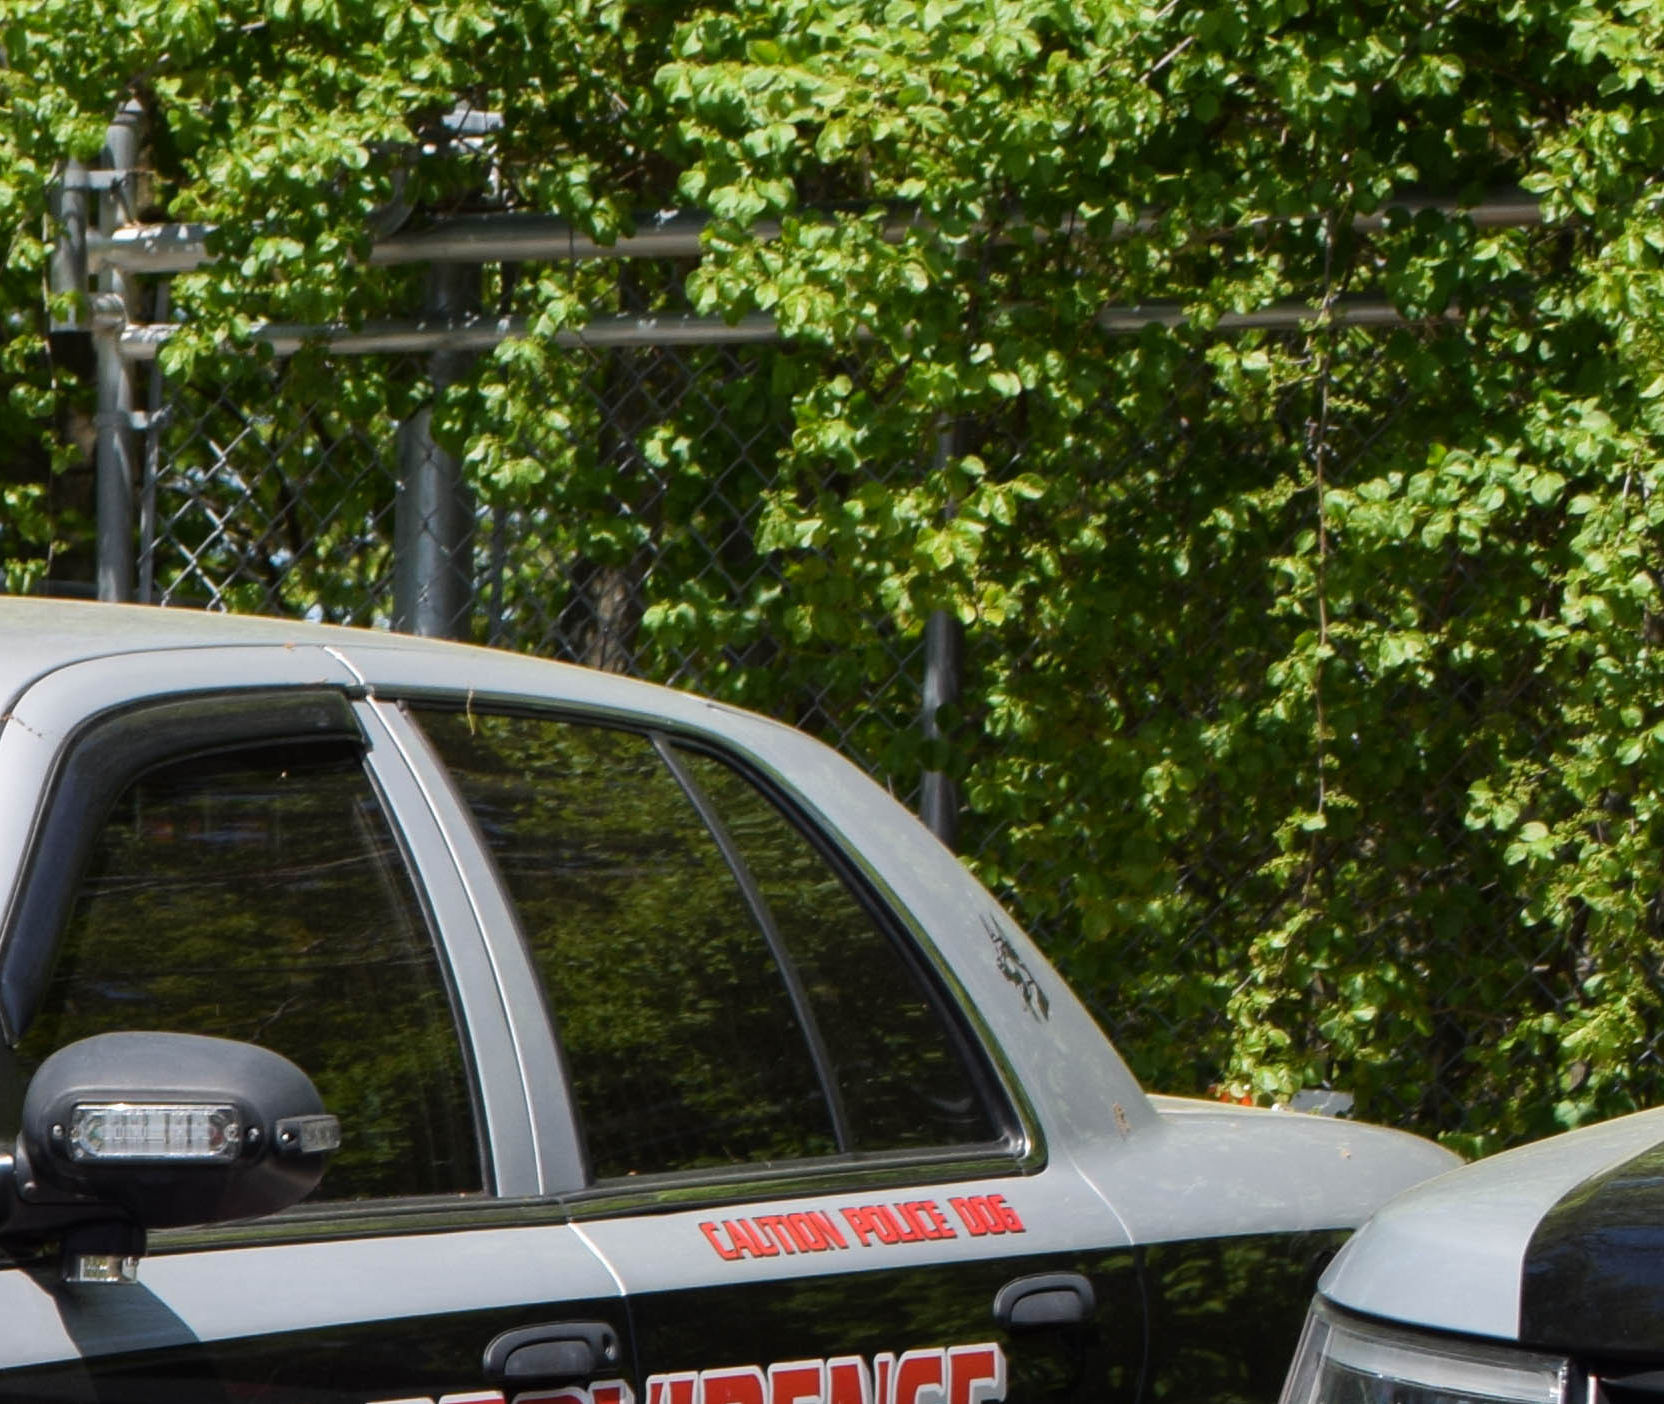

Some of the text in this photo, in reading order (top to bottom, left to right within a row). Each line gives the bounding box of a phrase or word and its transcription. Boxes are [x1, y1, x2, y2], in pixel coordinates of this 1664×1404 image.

[699, 1193, 1026, 1261] CAUTION POLICE DOG
